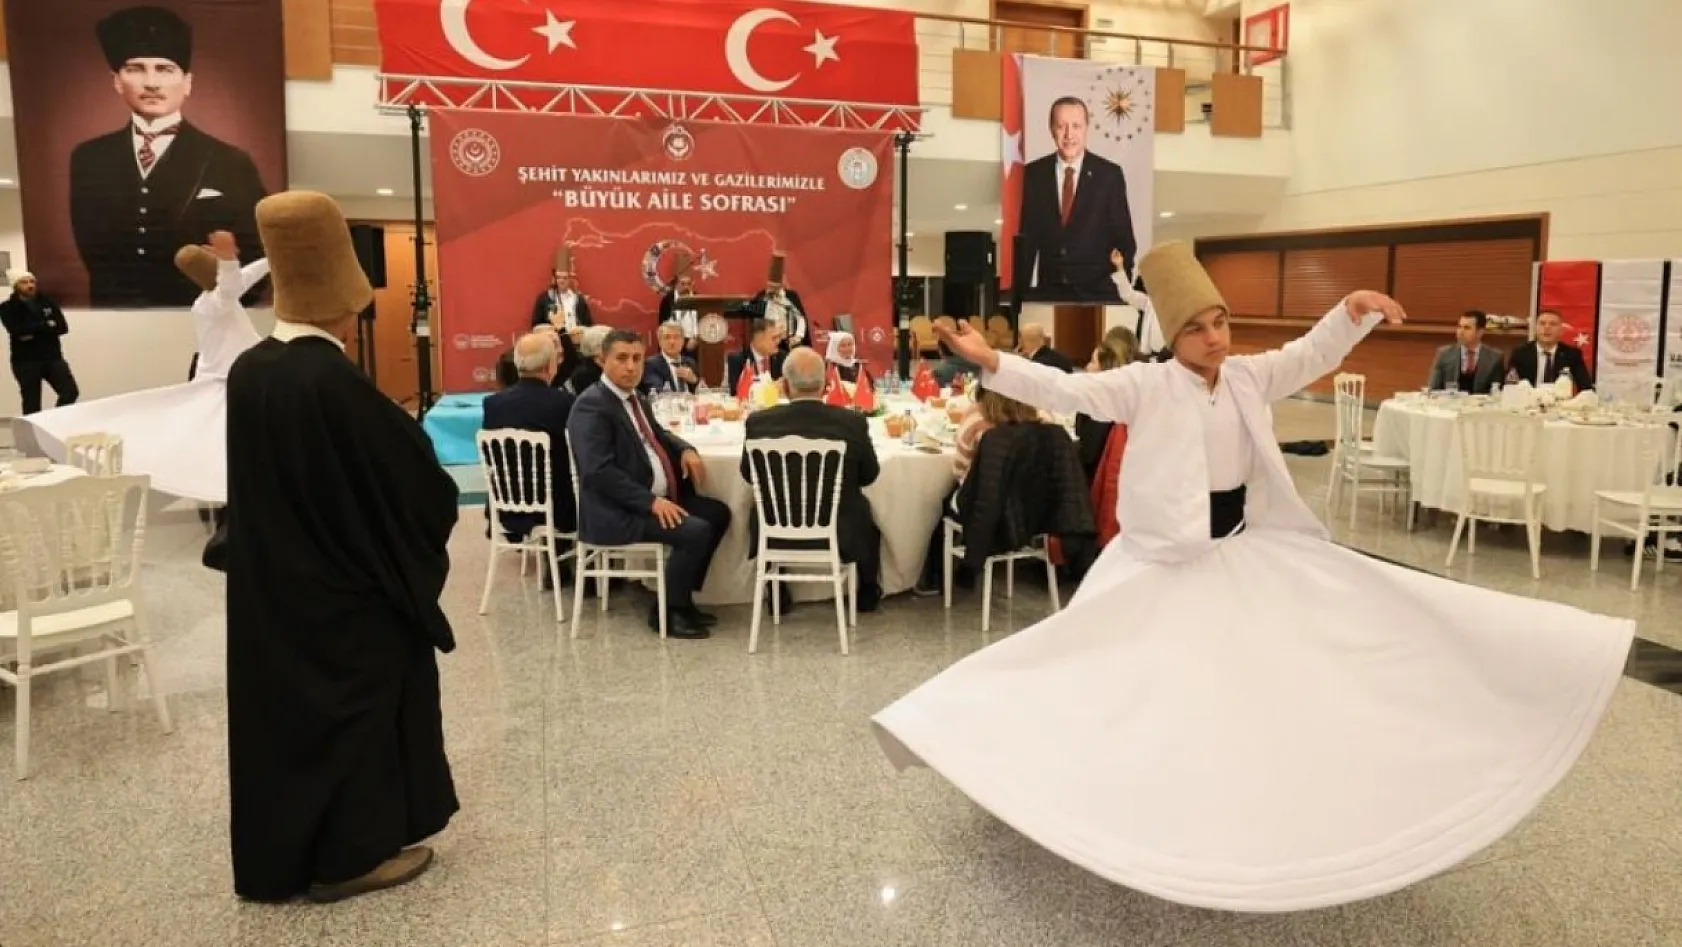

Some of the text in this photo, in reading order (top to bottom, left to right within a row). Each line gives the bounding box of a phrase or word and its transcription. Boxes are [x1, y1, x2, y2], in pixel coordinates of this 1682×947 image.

[517, 164, 826, 190] ŞEHİT YAKINLARIMIZ VE GAZİLERİMİZLE
[647, 188, 694, 210] AİLE
